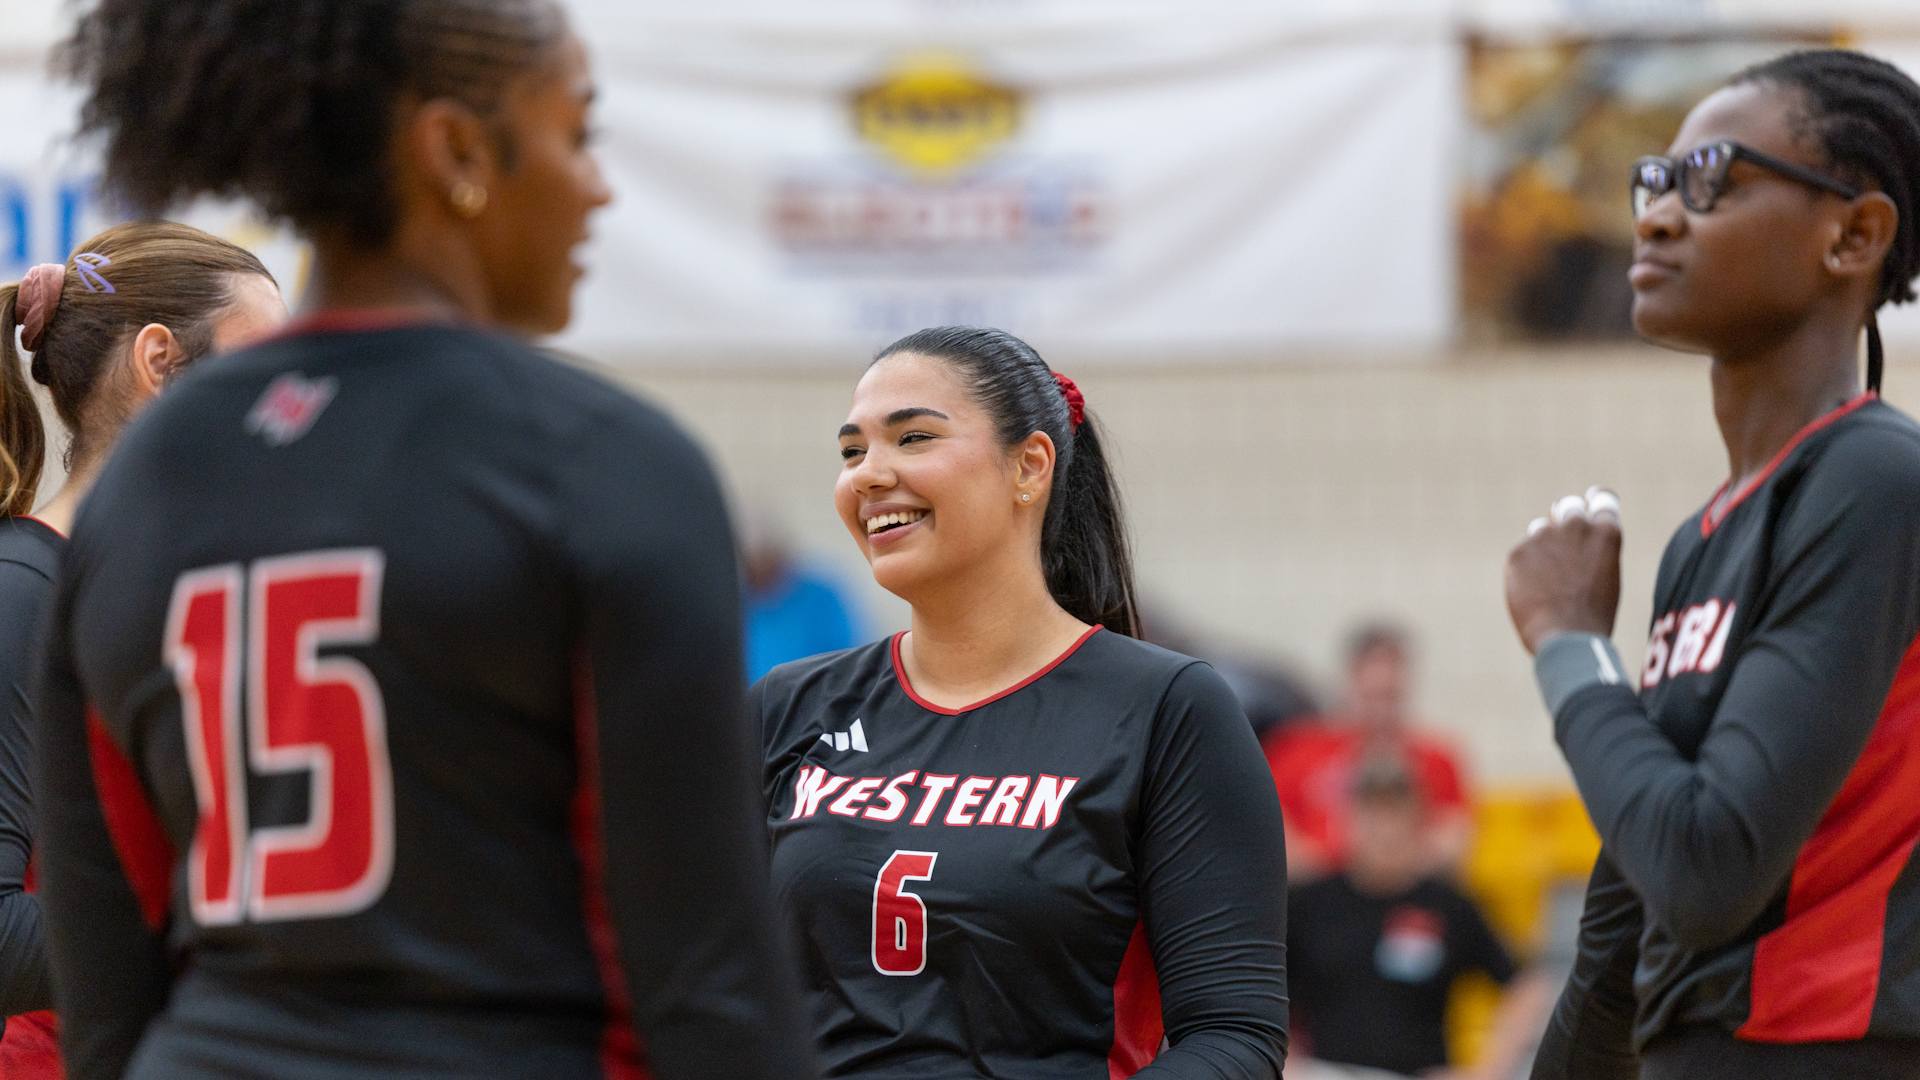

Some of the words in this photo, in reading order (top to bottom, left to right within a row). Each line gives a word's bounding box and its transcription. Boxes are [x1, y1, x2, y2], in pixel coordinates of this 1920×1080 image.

[163, 547, 396, 926] 15
[788, 765, 1080, 829] WESTERN
[871, 850, 938, 976] 6
